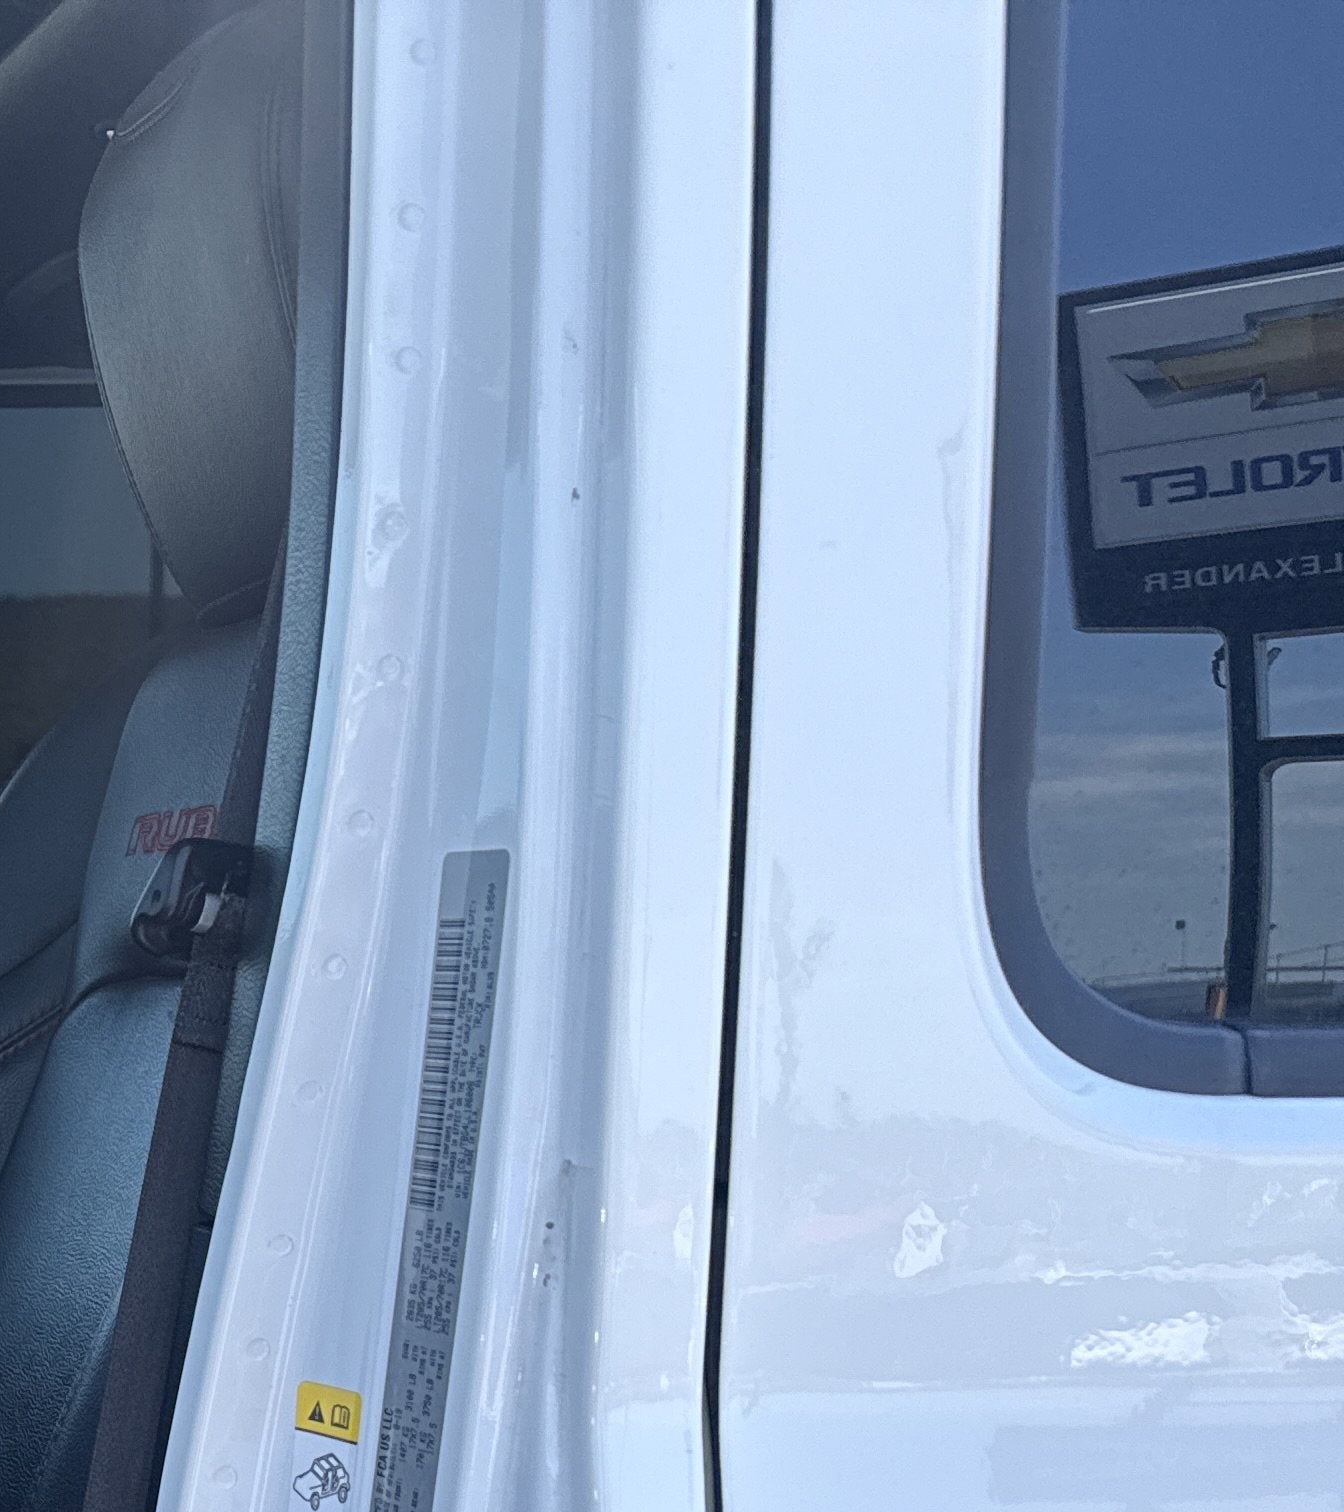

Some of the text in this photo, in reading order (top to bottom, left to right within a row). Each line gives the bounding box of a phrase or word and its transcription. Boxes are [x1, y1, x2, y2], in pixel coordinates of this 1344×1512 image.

[381, 1406, 394, 1431] LLC
[379, 1431, 391, 1452] US
[375, 1453, 388, 1478] FCA
